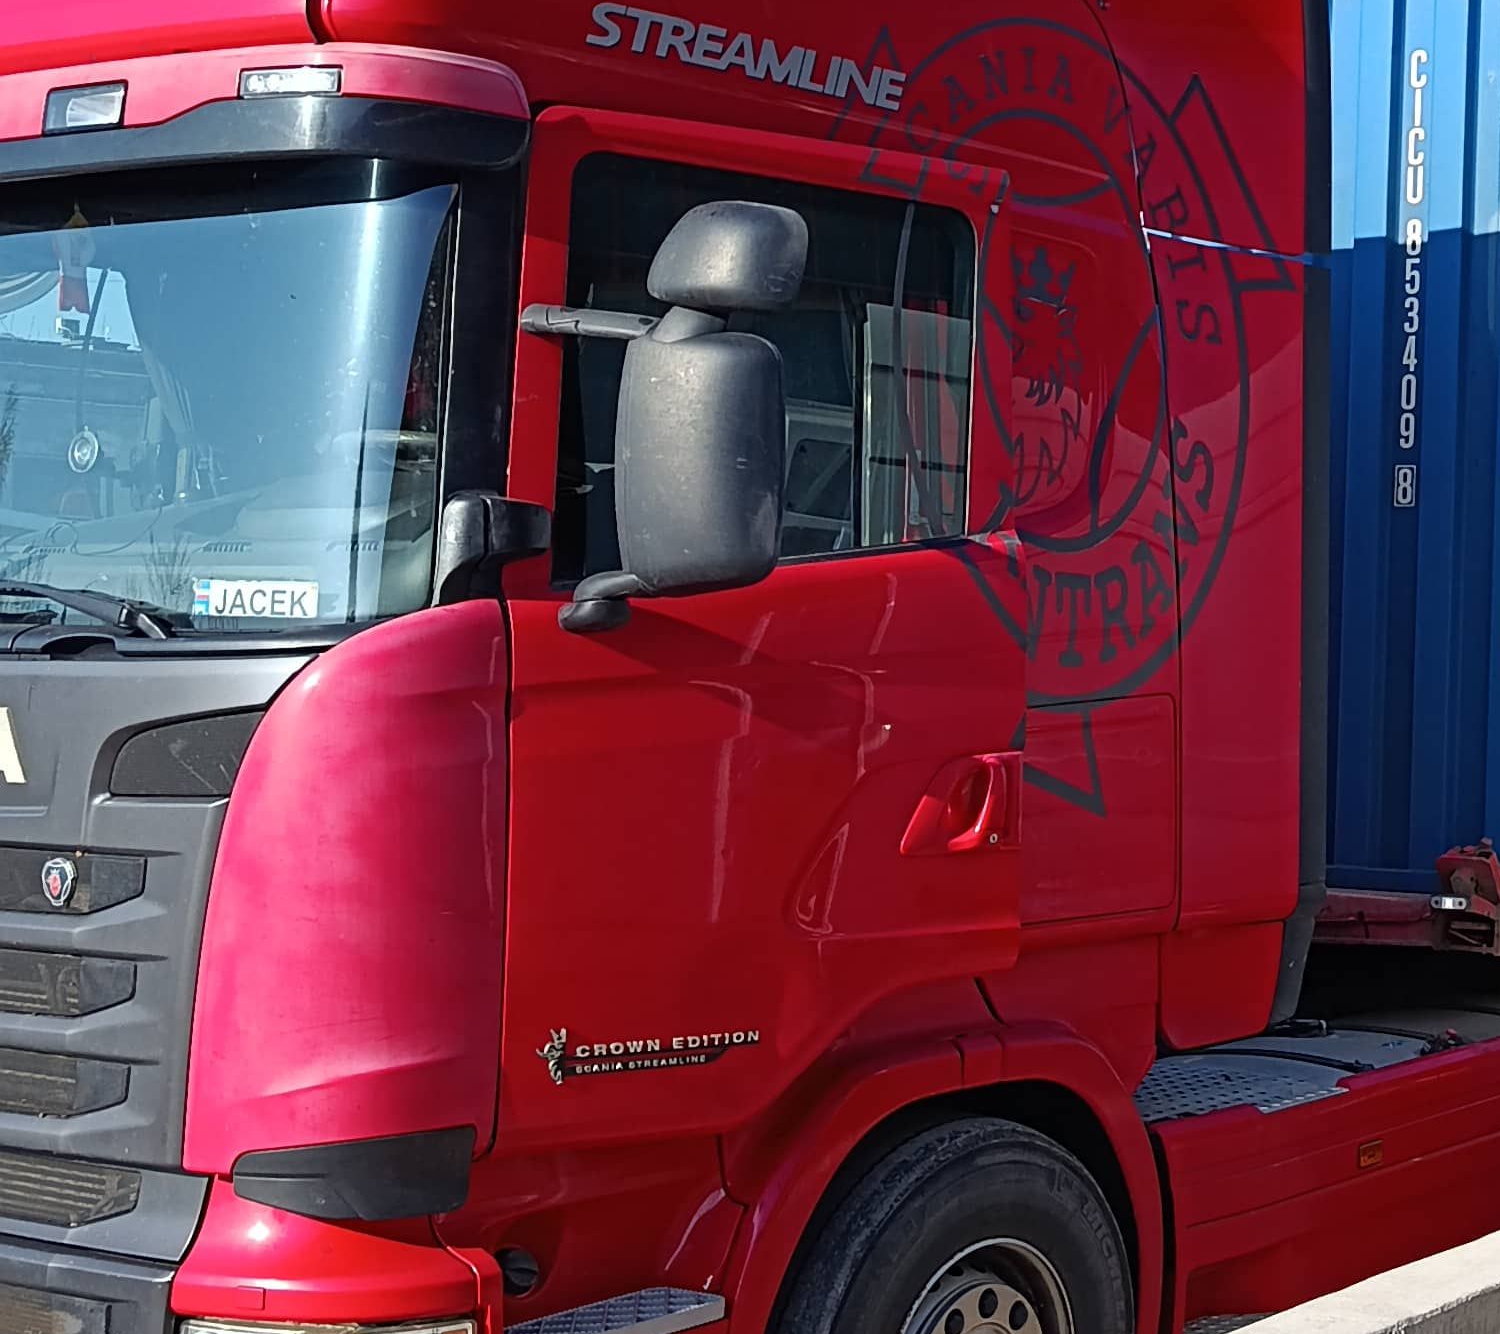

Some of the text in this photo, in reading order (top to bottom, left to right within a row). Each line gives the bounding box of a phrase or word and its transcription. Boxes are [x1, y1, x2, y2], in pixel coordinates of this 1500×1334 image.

[585, 1, 907, 111] STREAMLINE
[1396, 49, 1428, 505] CICU 853409 8
[215, 588, 308, 616] JACEK
[575, 1030, 760, 1058] CROWN EDITION
[575, 1054, 707, 1075] SCANIA STREAMLINE
